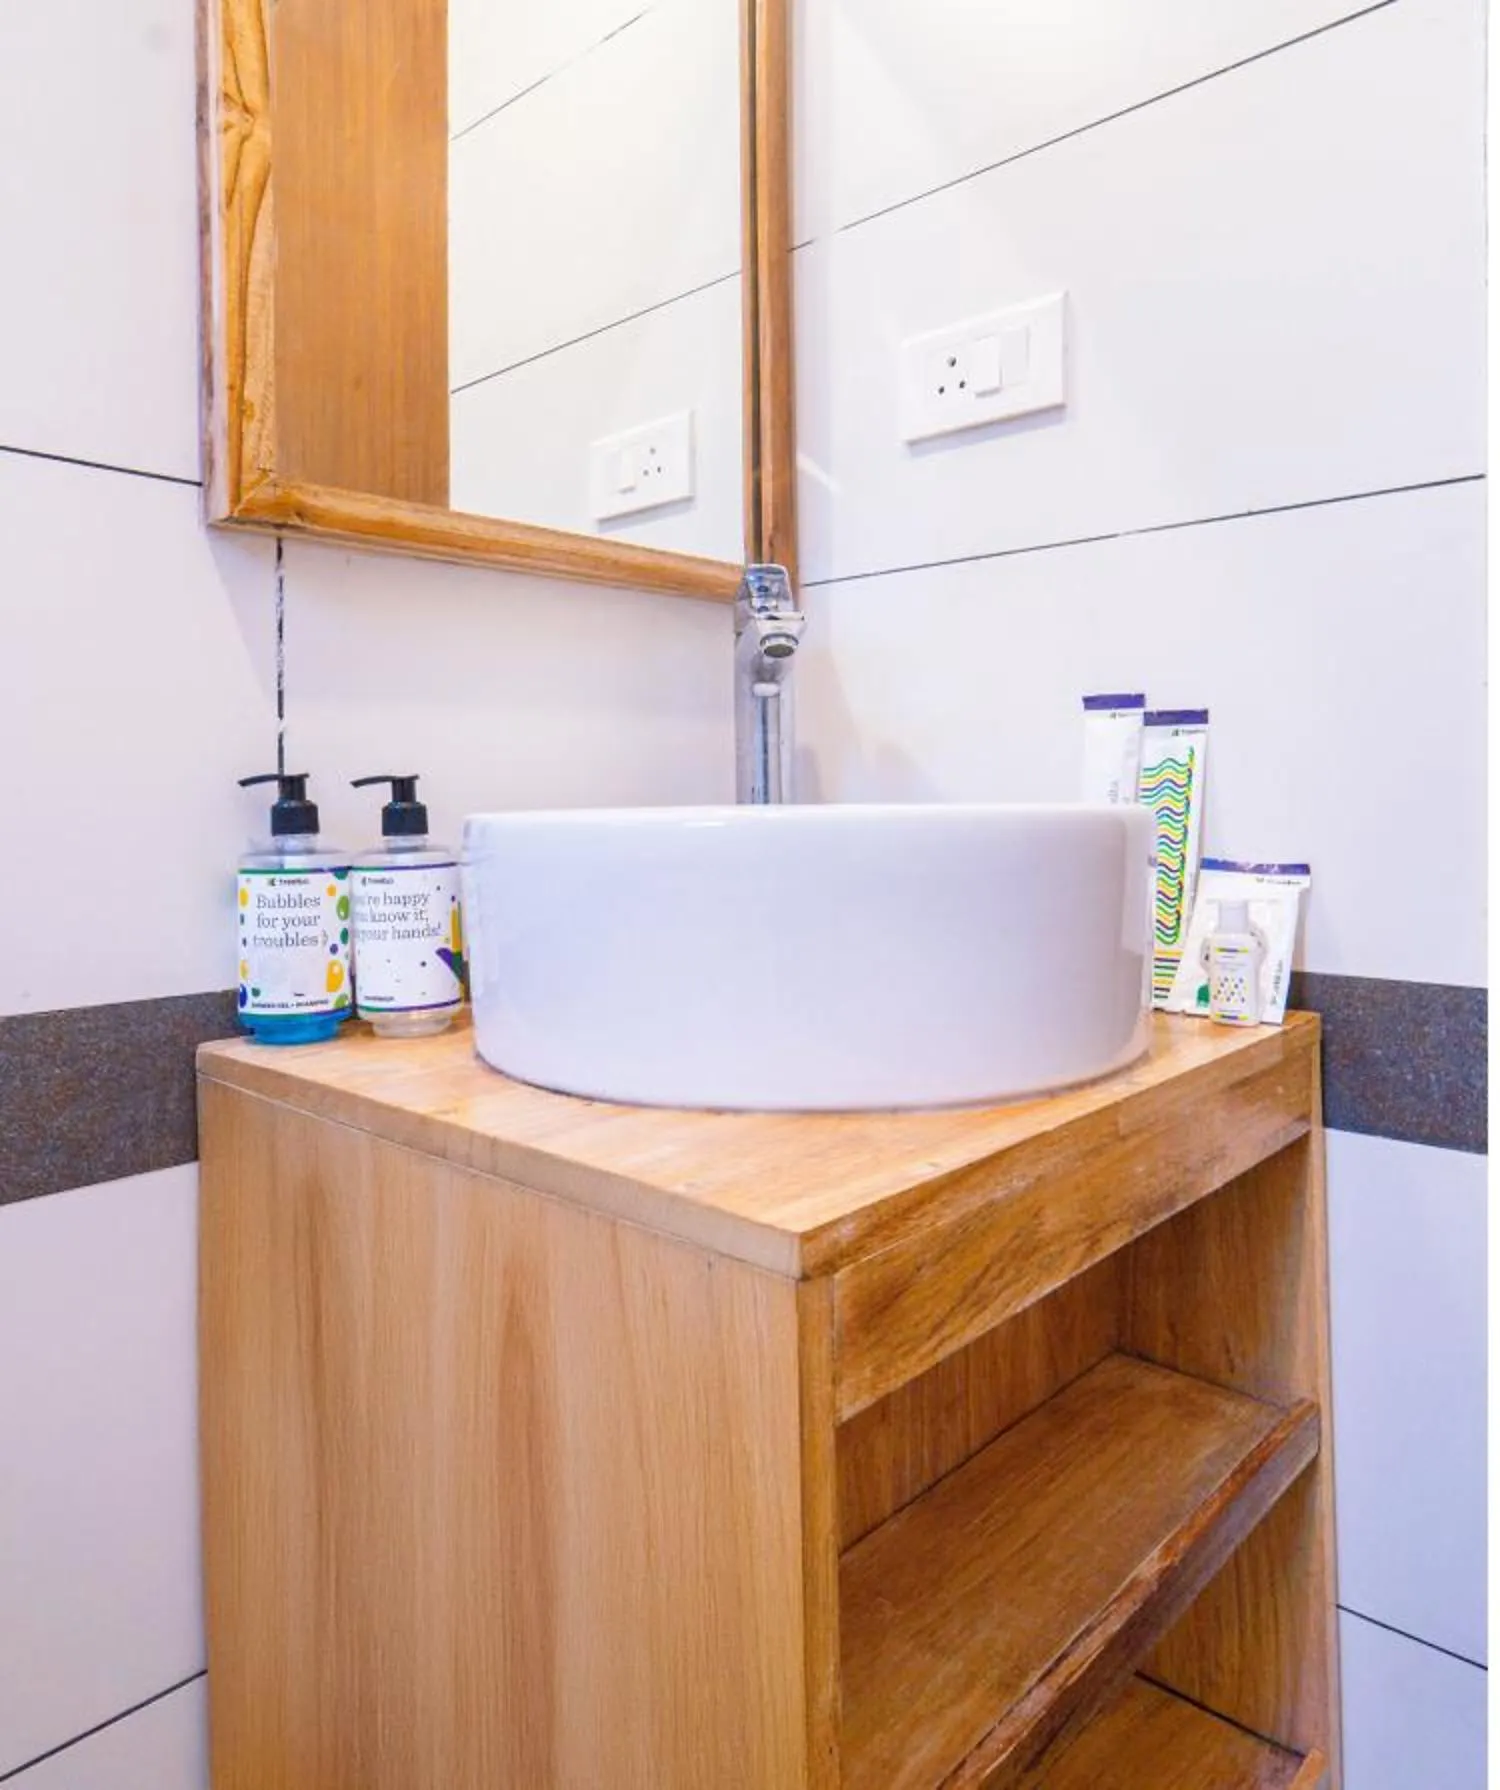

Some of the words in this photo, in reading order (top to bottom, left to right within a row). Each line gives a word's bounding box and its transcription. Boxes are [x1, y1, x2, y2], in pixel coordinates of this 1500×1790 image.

[256, 893, 321, 909] Bubbles
[382, 891, 431, 907] happy
[257, 911, 279, 928] for
[281, 914, 321, 931] your
[369, 908, 409, 923] know
[253, 931, 320, 949] troubles
